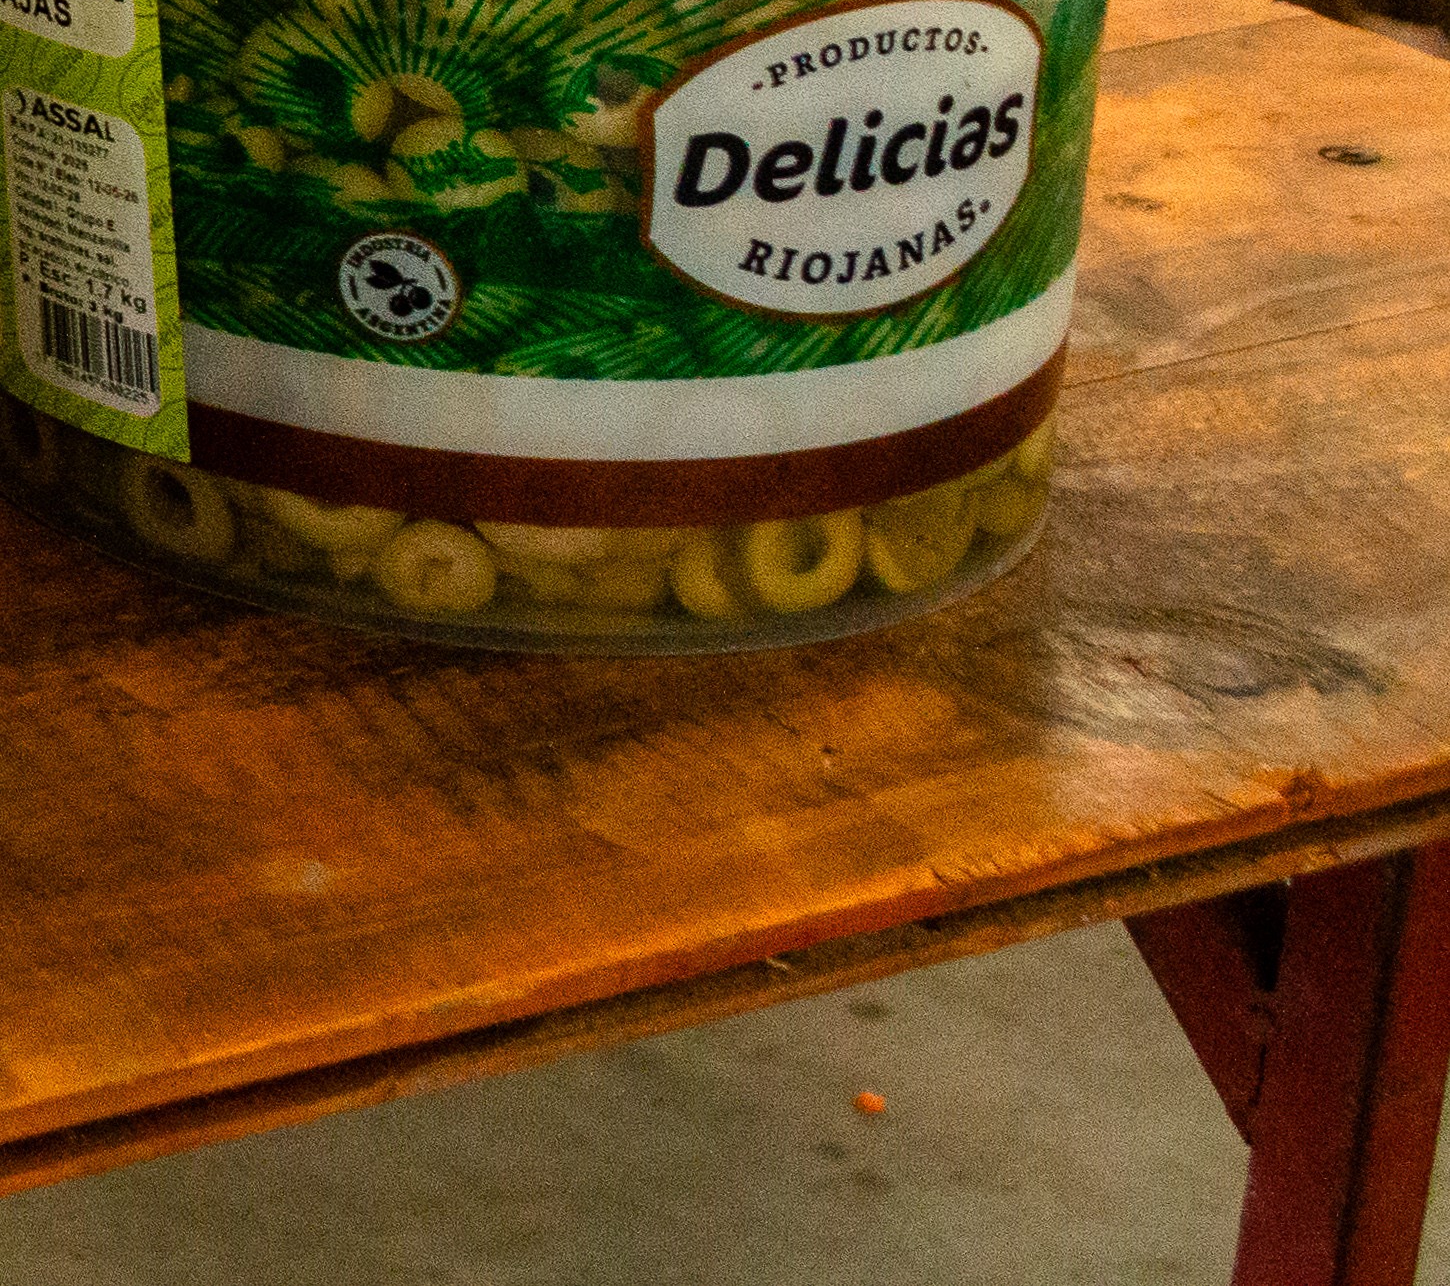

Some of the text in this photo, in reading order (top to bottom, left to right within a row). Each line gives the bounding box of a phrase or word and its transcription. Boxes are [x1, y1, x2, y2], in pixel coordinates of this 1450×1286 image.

[765, 27, 981, 90] PRODUCTOS
[673, 92, 1025, 208] Delicias
[347, 238, 431, 269] INDUSTRIA
[737, 198, 978, 286] RIOJANAS
[121, 289, 147, 314] kg
[355, 299, 452, 336] ARGENTINA
